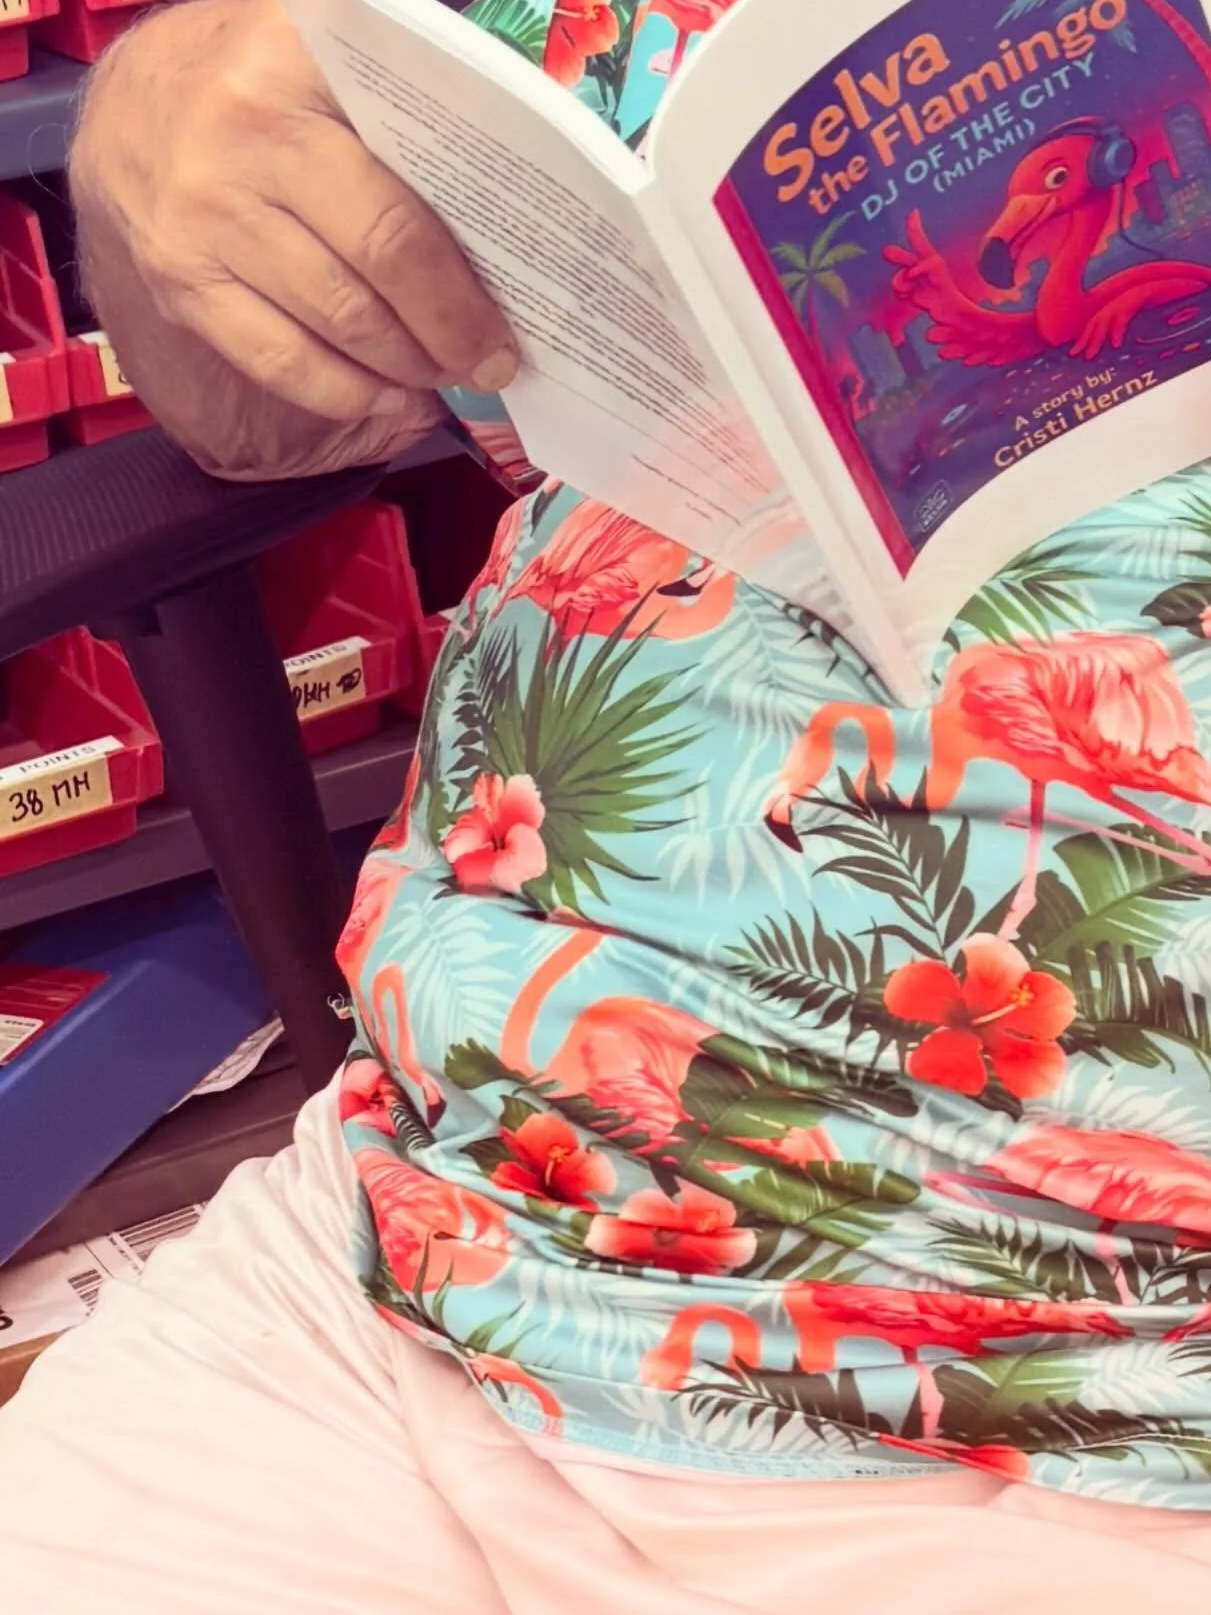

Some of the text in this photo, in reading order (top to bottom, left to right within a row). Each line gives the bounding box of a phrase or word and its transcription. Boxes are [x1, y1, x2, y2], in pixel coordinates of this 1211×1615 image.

[763, 32, 951, 203] Selva
[861, 52, 1096, 221] DJ OF THE CITY
[808, 154, 869, 215] the
[932, 118, 1037, 193] (MIAMI)
[994, 370, 1158, 467] Cristi Hernz
[1014, 415, 1030, 432] A
[1032, 385, 1085, 419] story
[9, 788, 44, 823] 38
